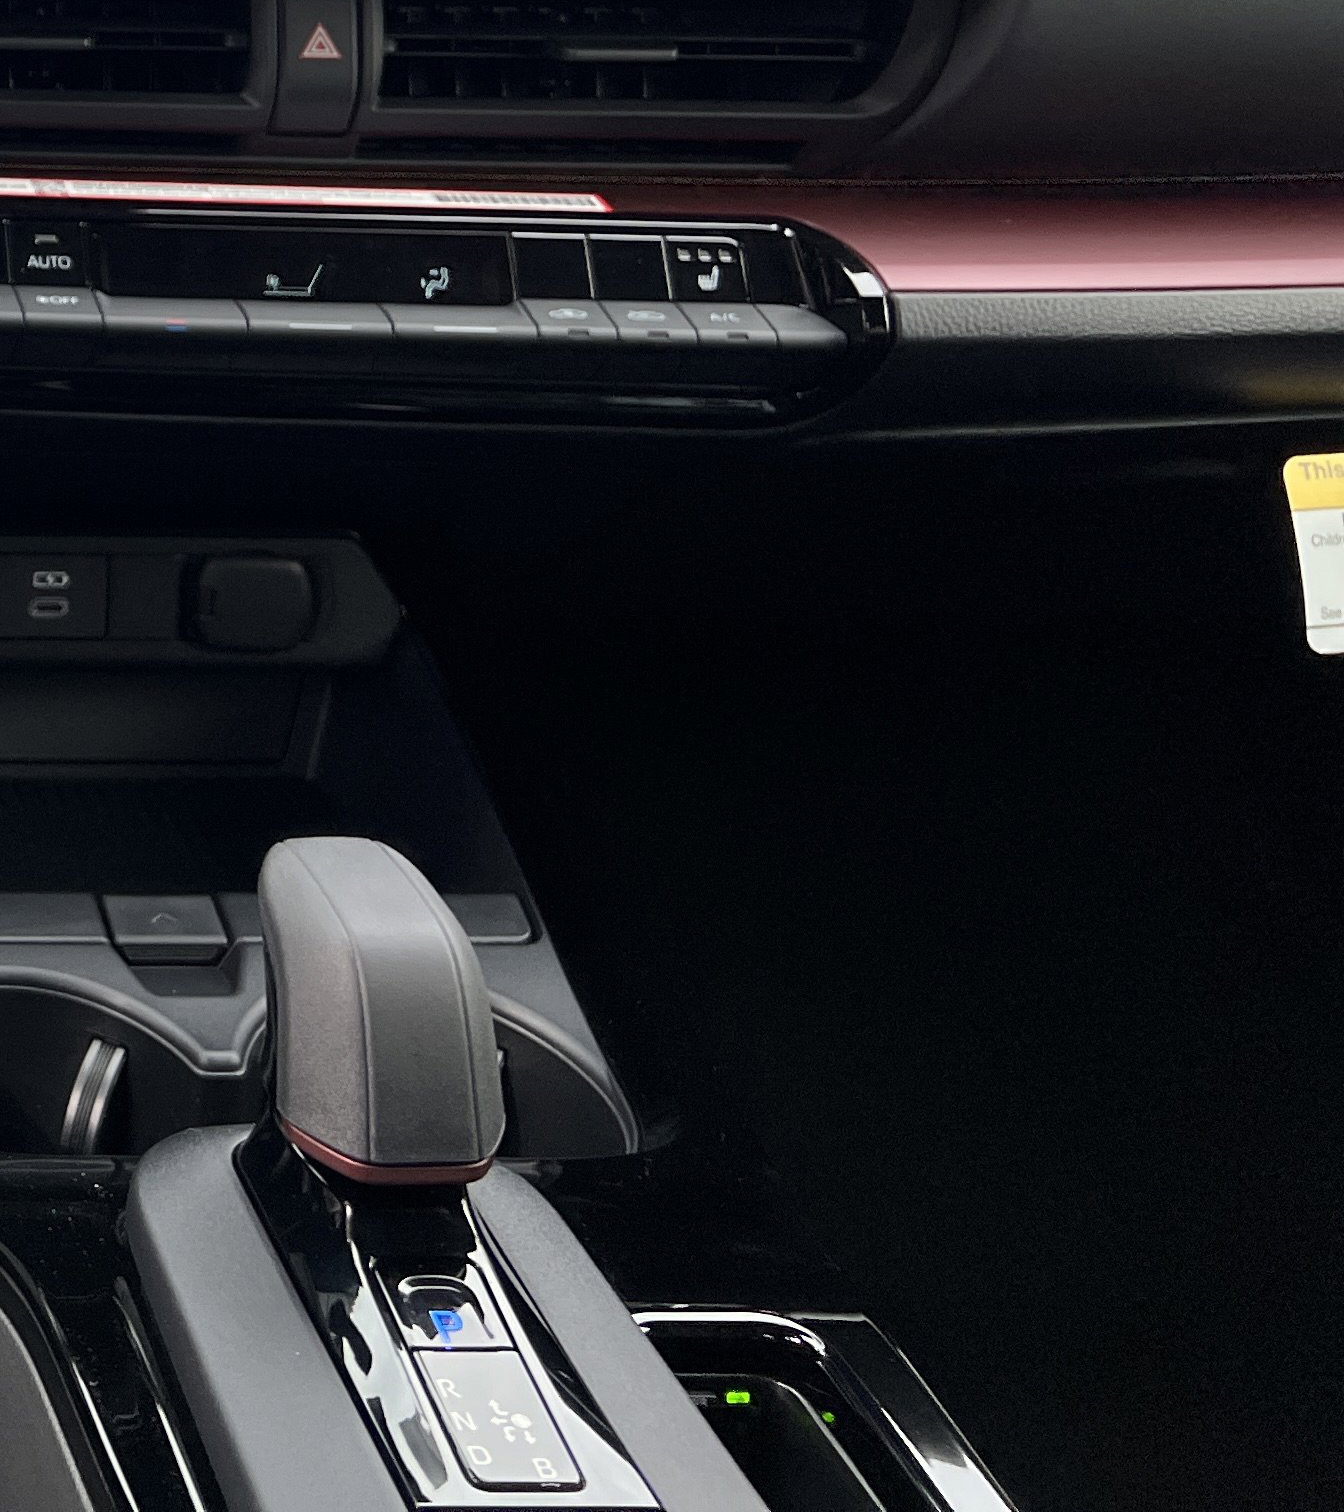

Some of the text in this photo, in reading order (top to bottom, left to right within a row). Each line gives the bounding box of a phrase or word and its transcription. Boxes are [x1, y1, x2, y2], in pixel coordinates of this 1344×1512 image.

[26, 253, 72, 271] AUTO
[428, 1309, 463, 1346] P
[437, 1378, 463, 1399] R
[448, 1409, 479, 1432] N
[469, 1445, 492, 1467] D
[533, 1457, 559, 1479] B
